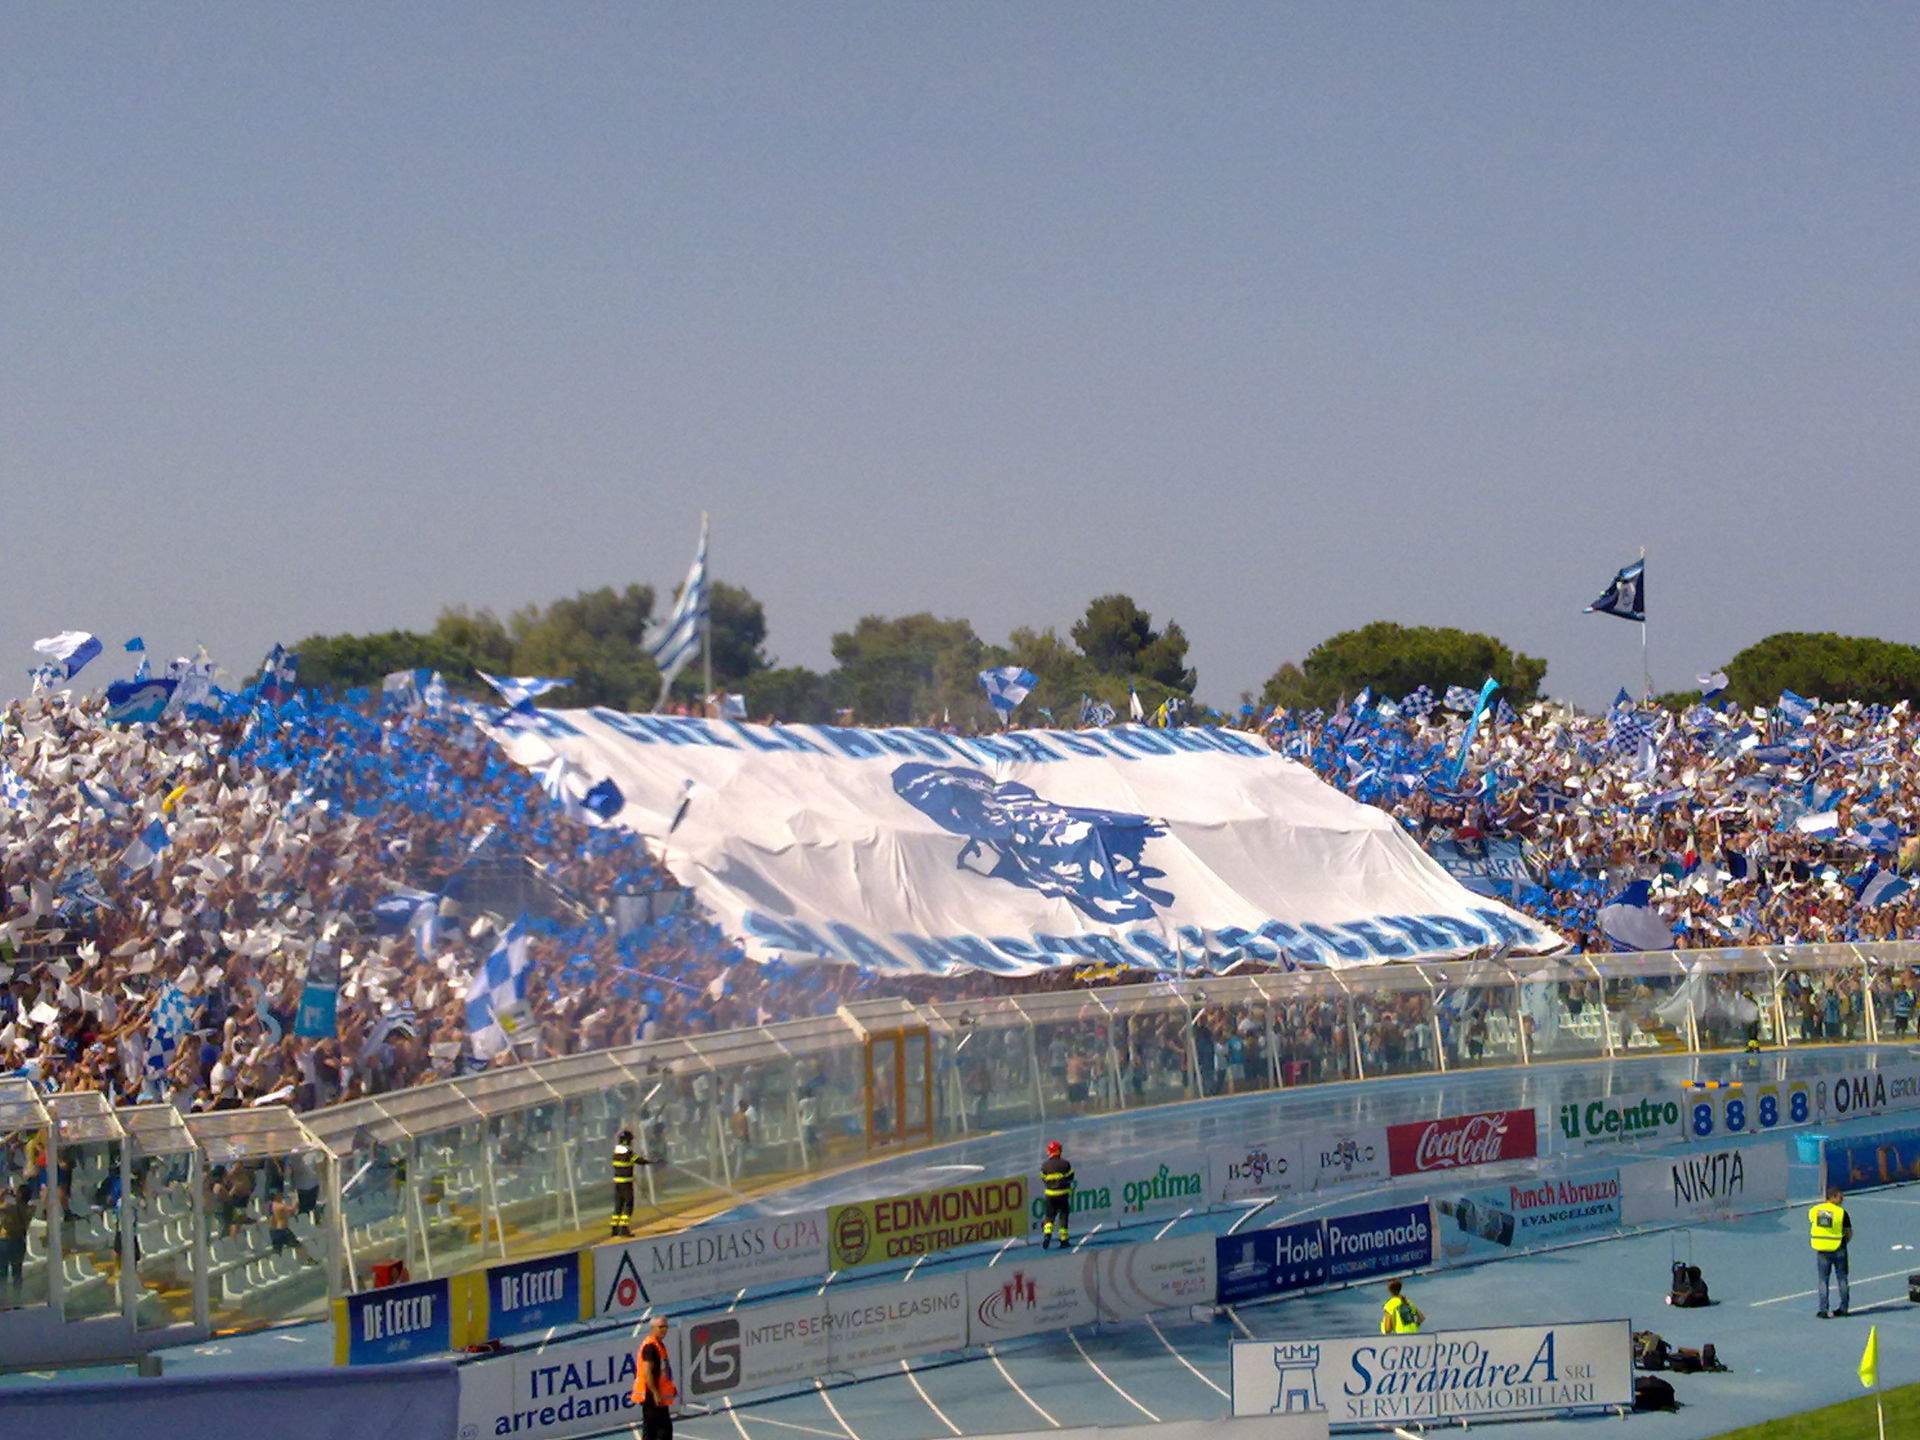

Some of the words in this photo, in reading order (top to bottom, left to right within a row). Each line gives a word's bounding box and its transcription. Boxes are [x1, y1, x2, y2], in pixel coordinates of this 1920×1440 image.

[1834, 1073, 1887, 1113] OMA
[1585, 1098, 1679, 1135] Centro
[1032, 1181, 1112, 1219] oima
[1123, 1164, 1203, 1212] optima
[1509, 1181, 1555, 1210] Punch
[1672, 1151, 1744, 1207] NIKITA
[874, 1181, 1024, 1234] EDMONDO
[1521, 1203, 1615, 1227] EVANGELISTA
[651, 1228, 765, 1275] MEDIASS
[773, 1218, 821, 1251] GPA
[886, 1216, 1013, 1258] COSTRUZIONI
[1276, 1228, 1324, 1266] Hotel
[1329, 1213, 1428, 1256] Promenade
[501, 1275, 521, 1311] DE
[522, 1267, 565, 1307] CECCO
[363, 1303, 384, 1342] DE
[385, 1295, 433, 1337] CECCO
[1344, 1330, 1559, 1397] SarandreA
[1380, 1340, 1480, 1371] GRUPPO
[495, 1390, 637, 1436] arredame
[1346, 1394, 1438, 1418] SERVIZI
[1441, 1383, 1595, 1413] IMMOBILIARI
